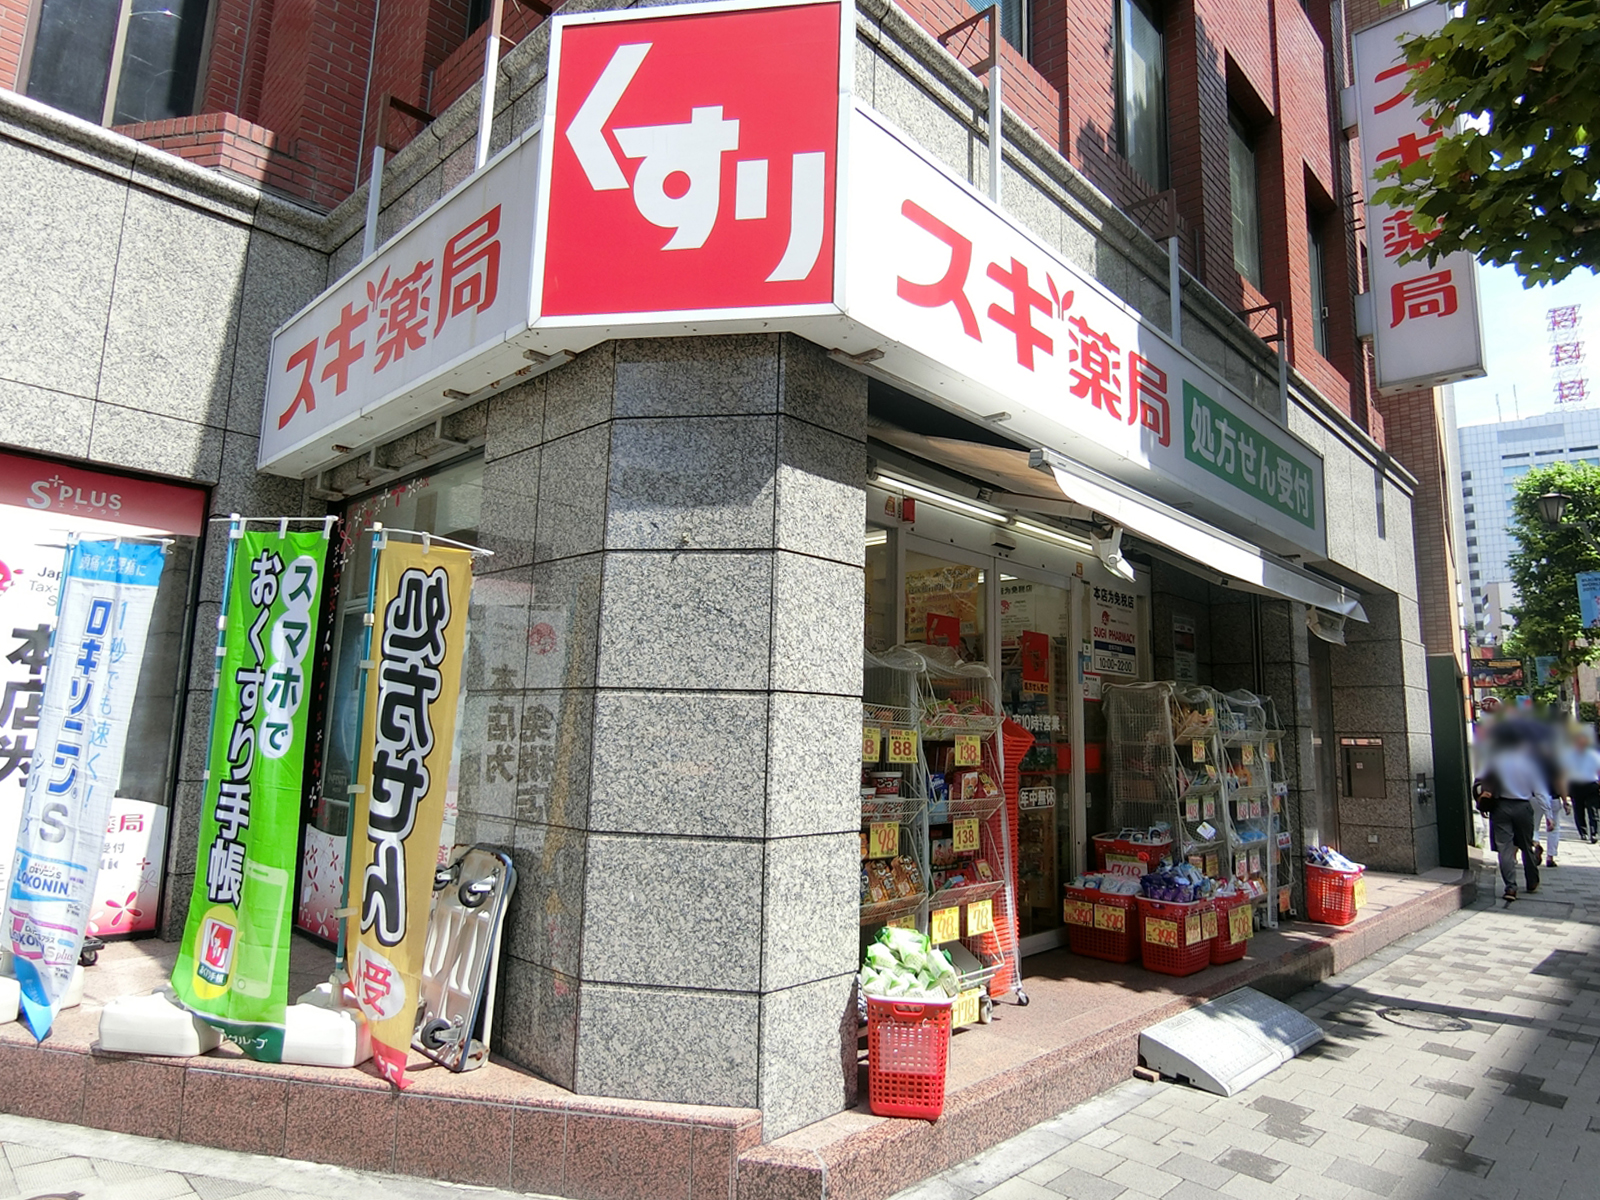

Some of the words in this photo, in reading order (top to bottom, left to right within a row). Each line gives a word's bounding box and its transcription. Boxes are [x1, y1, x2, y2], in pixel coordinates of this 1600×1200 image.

[565, 42, 825, 282] くすり
[278, 203, 502, 431] スギ薬局
[896, 198, 1171, 448] スギ薬局
[1190, 399, 1310, 518] 処方せん受付
[263, 565, 314, 750] スマホで
[1093, 626, 1107, 638] SUGI
[1108, 629, 1136, 644] PHARMACY
[48, 599, 114, 793] ロキソニン
[208, 550, 283, 908] おくすり手帳
[892, 740, 912, 756] 88
[960, 744, 977, 761] 138
[1020, 790, 1055, 806] 年中無休
[878, 827, 897, 852] 98
[956, 829, 975, 846] 138
[1152, 926, 1177, 947] 398
